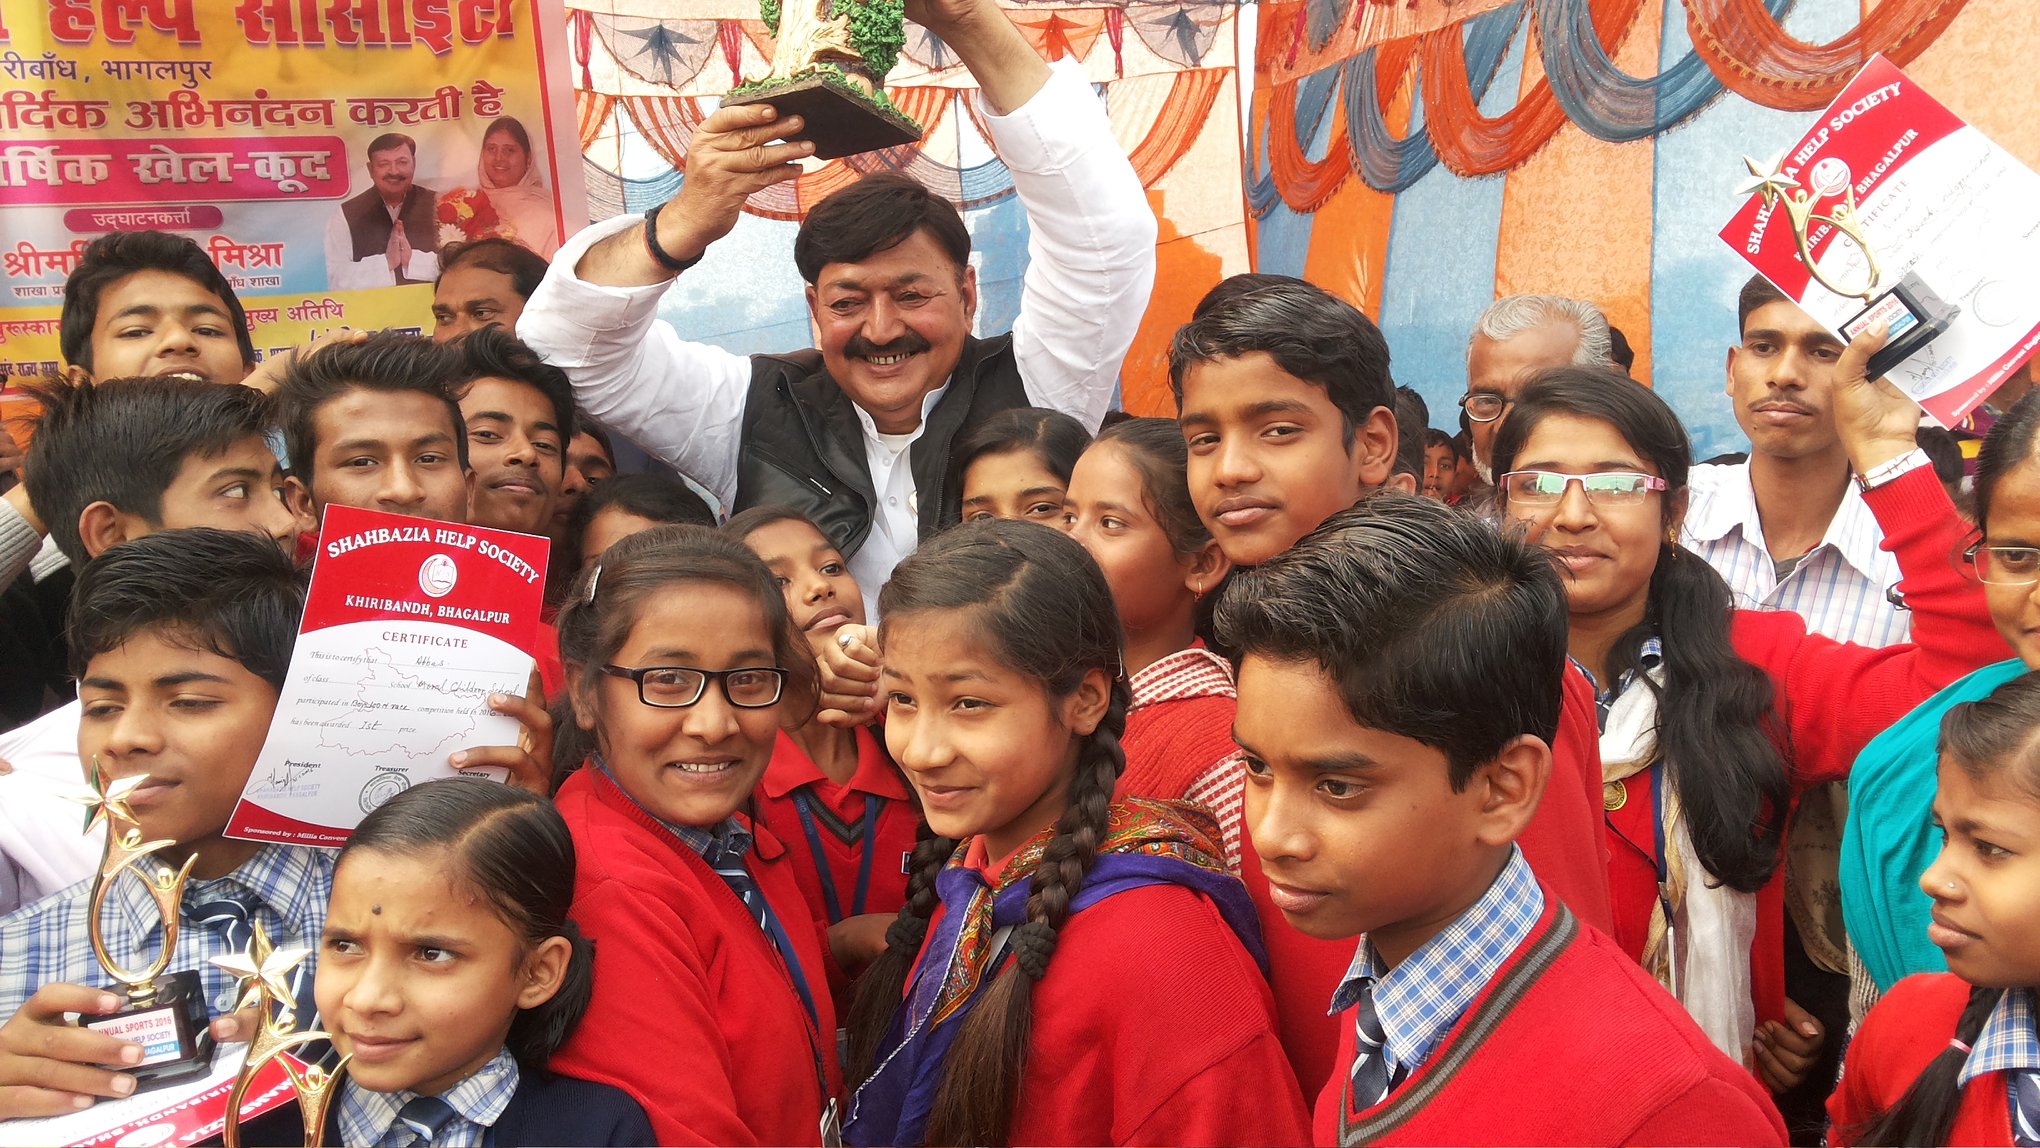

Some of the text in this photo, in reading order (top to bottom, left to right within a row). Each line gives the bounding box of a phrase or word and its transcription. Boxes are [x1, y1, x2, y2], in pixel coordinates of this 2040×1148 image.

[101, 60, 212, 88] भागलपुर
[126, 89, 336, 130] अभिनंदन
[346, 85, 463, 127] करती
[471, 79, 504, 117] है
[1793, 127, 1830, 167] HELP
[1829, 81, 1902, 132] SOCIETY
[127, 145, 331, 193] खेल-कूद
[1855, 128, 1919, 195] BHAGALPUR
[208, 235, 284, 270] मिश्रा
[14, 286, 47, 297] शाखा
[251, 276, 280, 287] शाखा
[287, 299, 344, 321] अतिथि
[327, 527, 540, 584] SHAHBAZIA HELP SOCIETY
[345, 594, 511, 625] KHIRIBANDH, BHAGALPUR
[382, 631, 468, 649] CERTIFICATE
[310, 651, 324, 660] This
[340, 655, 362, 664] certify
[363, 656, 378, 664] that
[303, 674, 313, 684] of
[312, 674, 329, 683] class
[389, 681, 411, 689] School
[296, 698, 340, 707] participated
[417, 706, 454, 715] competition
[456, 707, 468, 715] held
[304, 718, 320, 727] been
[320, 720, 351, 729] awarded
[284, 760, 491, 778] President Treasurer Secretary
[243, 826, 281, 836] Sponsored
[282, 830, 292, 838] by
[296, 832, 318, 840] Millia
[318, 833, 348, 841] Convent
[125, 1019, 154, 1033] SPORTS
[155, 1016, 172, 1027] 2016
[146, 1030, 171, 1042] SOCIETY
